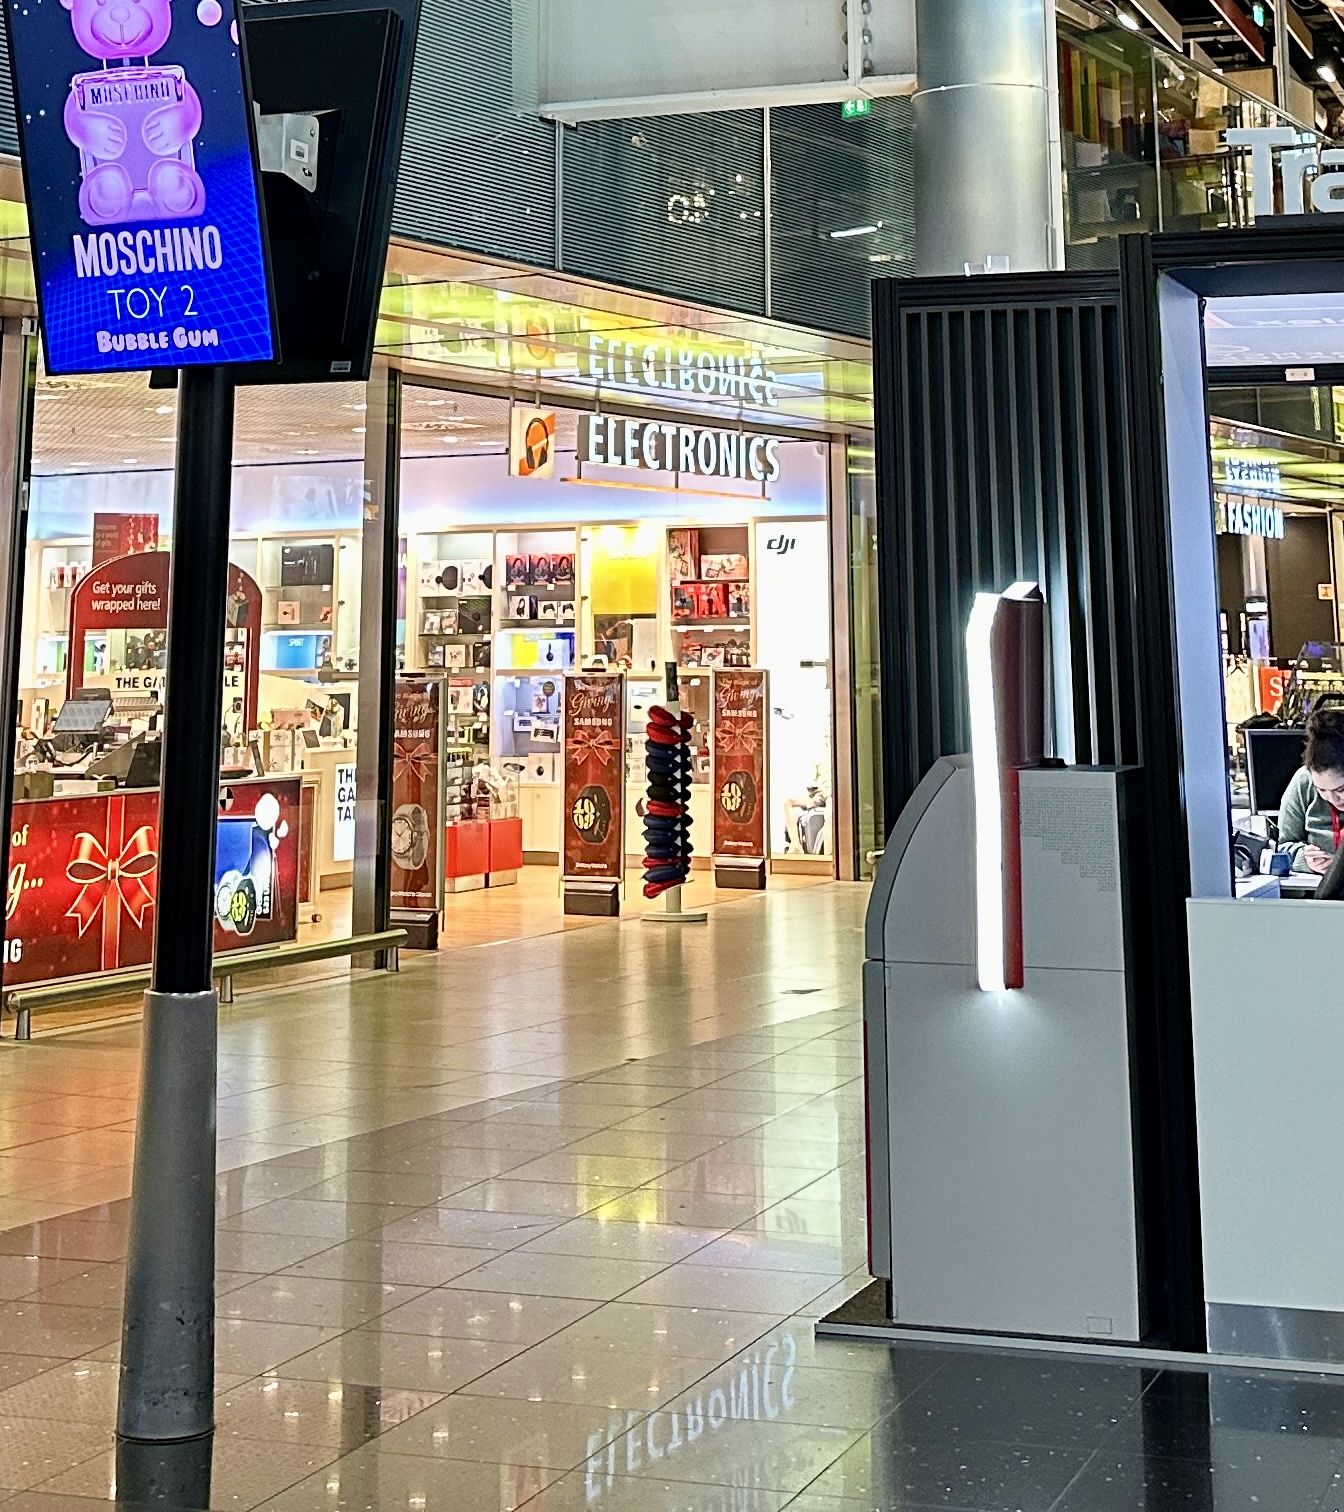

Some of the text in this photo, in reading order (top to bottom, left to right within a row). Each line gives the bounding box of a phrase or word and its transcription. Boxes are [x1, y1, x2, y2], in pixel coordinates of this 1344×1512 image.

[90, 79, 171, 106] MOSCHINO
[73, 225, 223, 278] MOSCHINO
[107, 285, 199, 320] TOY 2
[588, 416, 780, 482] ELECTRONICS
[1227, 501, 1284, 539] FASHION
[92, 581, 157, 597] Get your gifts
[92, 597, 160, 613] wrapped here!
[116, 677, 140, 689] THE
[394, 729, 431, 739] AMSUNG
[12, 824, 29, 847] of
